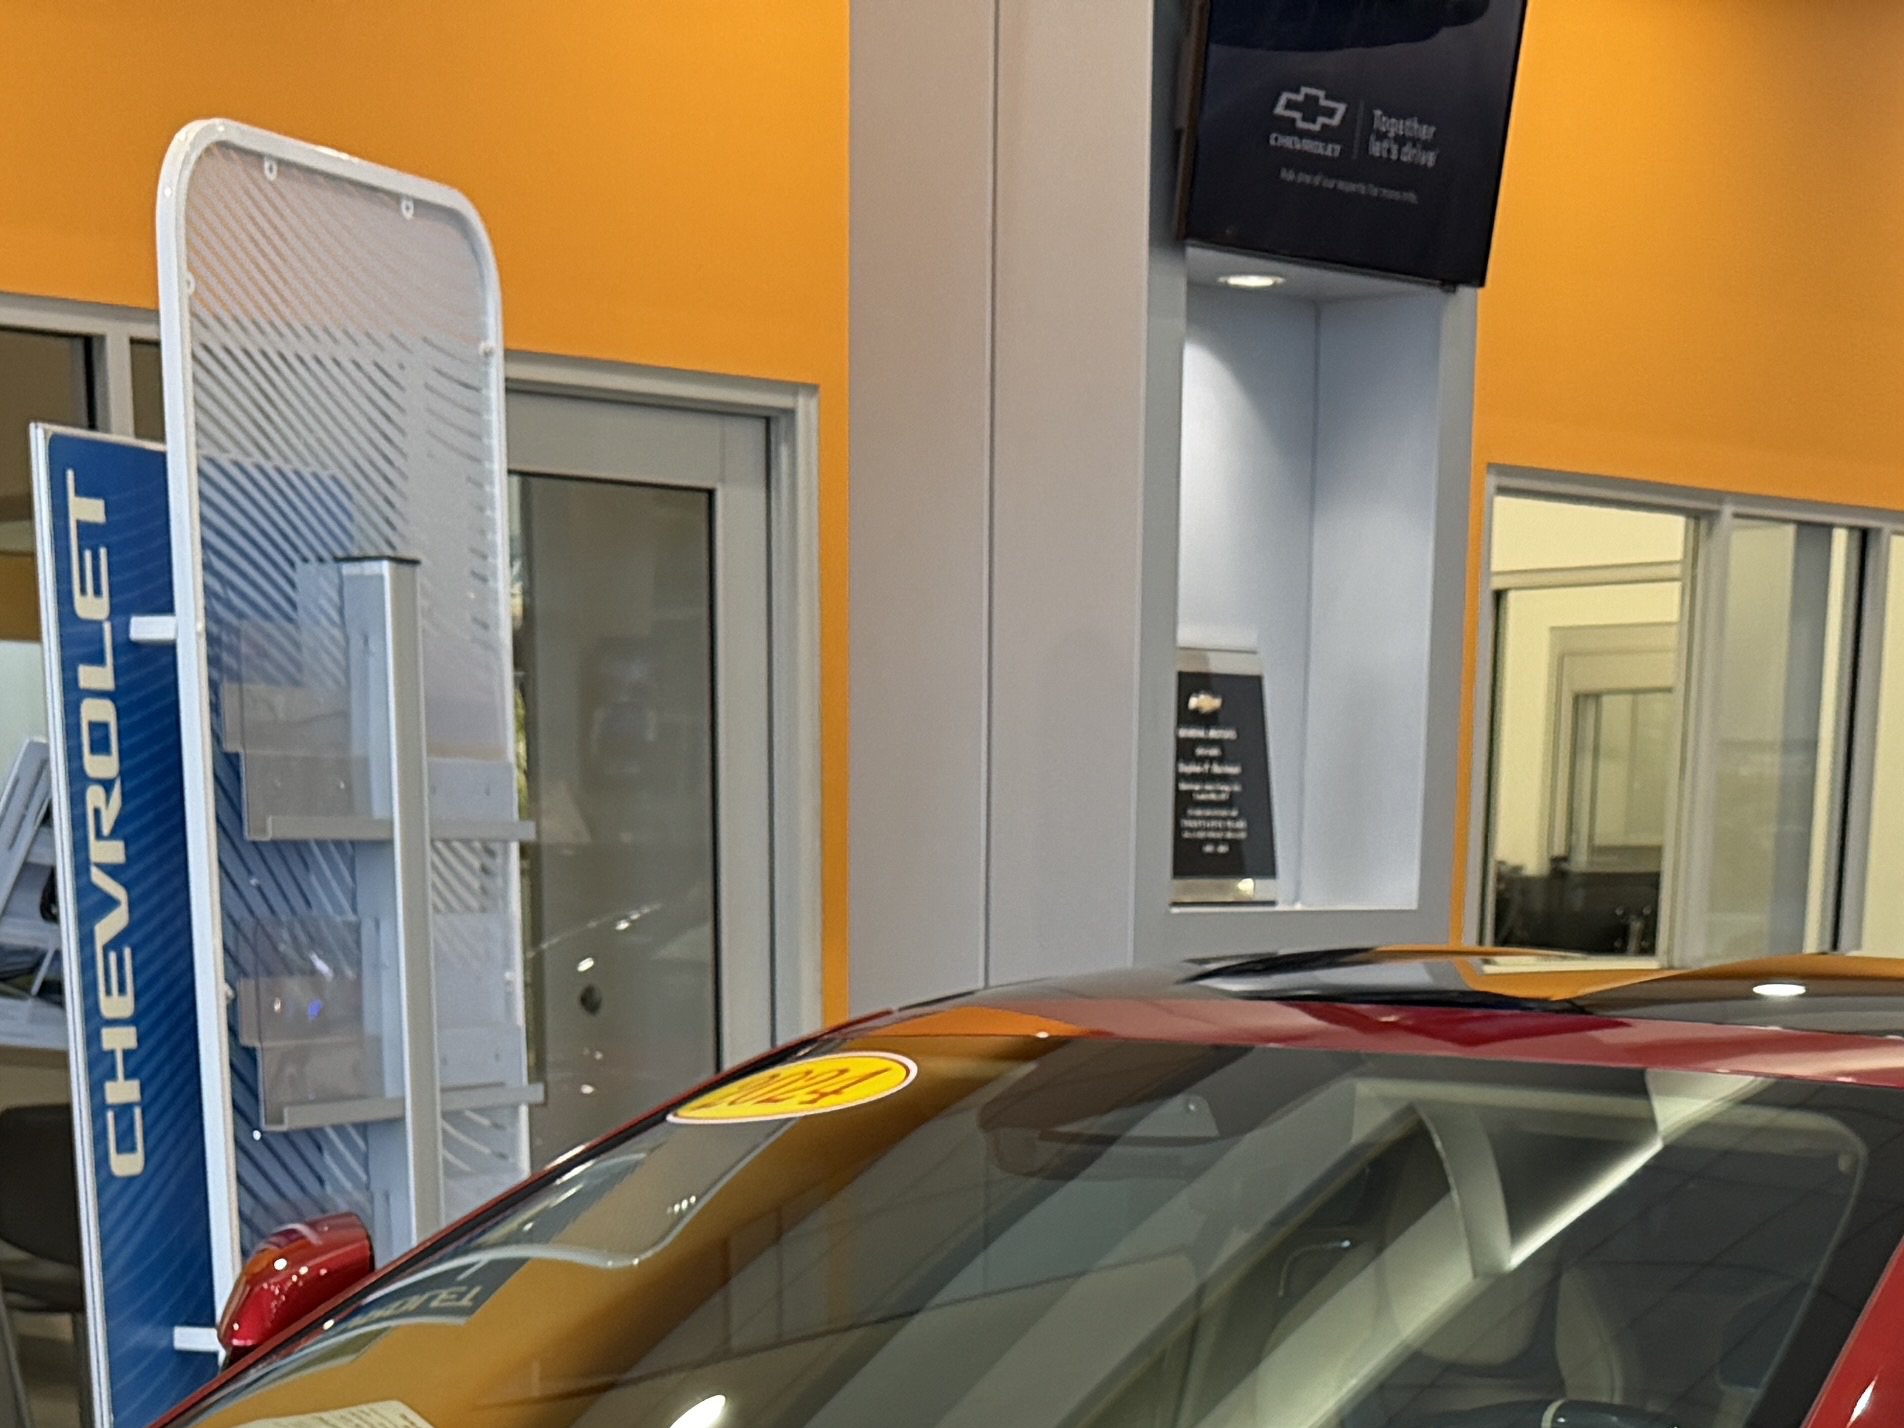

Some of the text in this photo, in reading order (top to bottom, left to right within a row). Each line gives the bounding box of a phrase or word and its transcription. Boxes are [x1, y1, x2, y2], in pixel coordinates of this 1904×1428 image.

[1372, 109, 1437, 141] Together
[65, 468, 146, 1178] CHEVROLET
[689, 1066, 892, 1112] 2024
